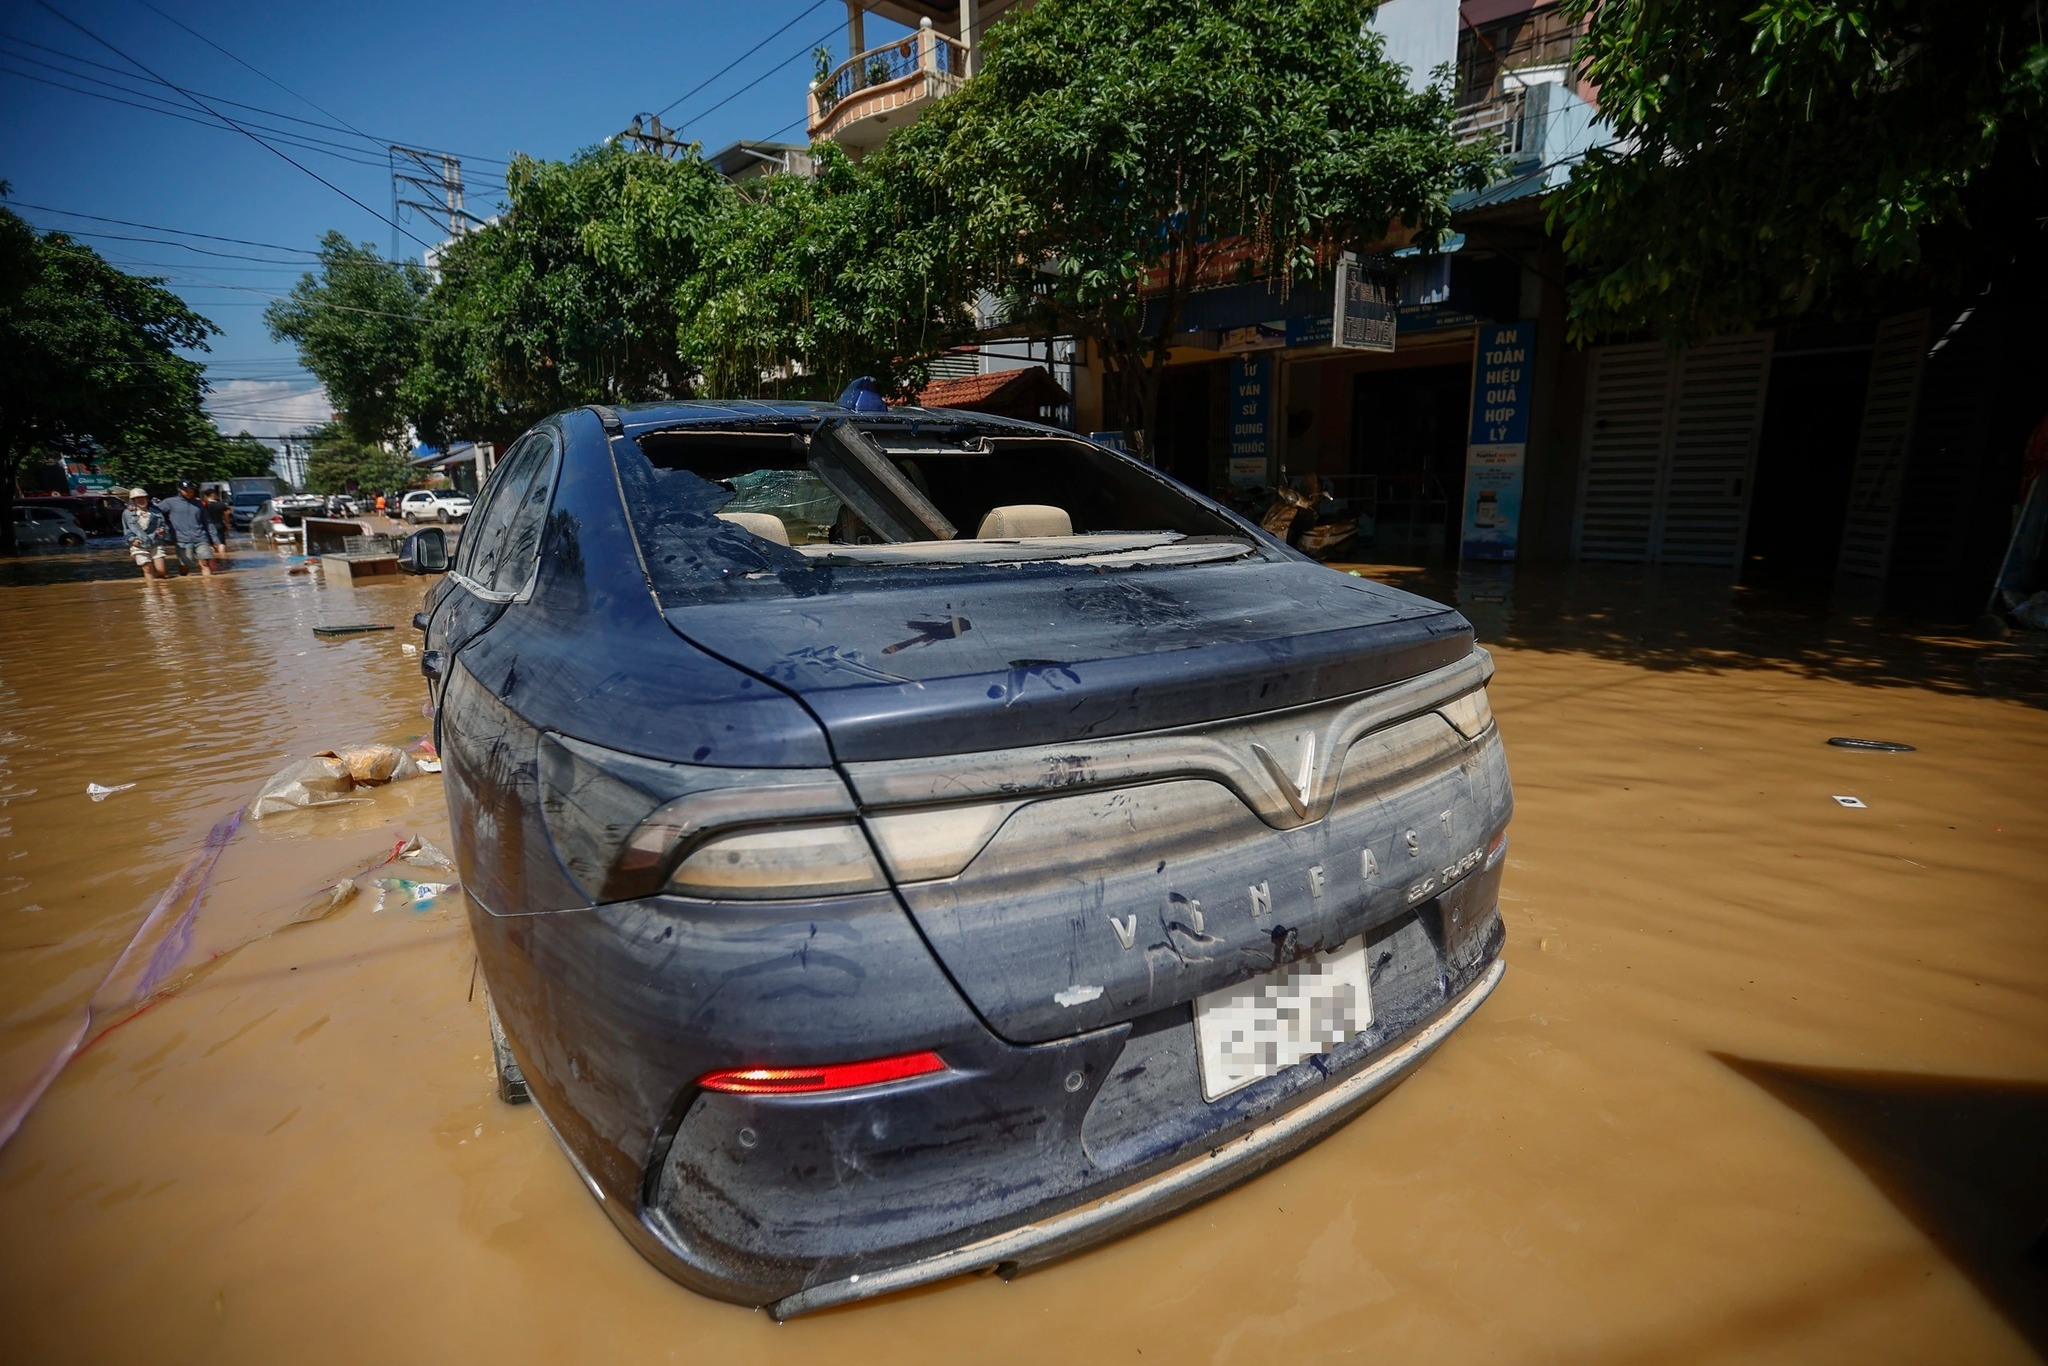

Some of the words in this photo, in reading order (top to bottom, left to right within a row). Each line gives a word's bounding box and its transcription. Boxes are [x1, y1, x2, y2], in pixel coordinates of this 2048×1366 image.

[1495, 329, 1518, 345] AN
[1485, 347, 1525, 365] TOÀN
[1486, 368, 1521, 386] HIỆU
[1239, 380, 1261, 397] VẤN
[1487, 384, 1517, 404] QUẢ
[1242, 400, 1258, 416] SỬ
[1485, 406, 1515, 425] HỢP
[1234, 423, 1263, 437] DỤNG
[1489, 424, 1508, 442] LÝ
[1232, 437, 1265, 454] THUỐC
[1442, 846, 1484, 885] TURBO
[1110, 809, 1453, 950] VINFAST
